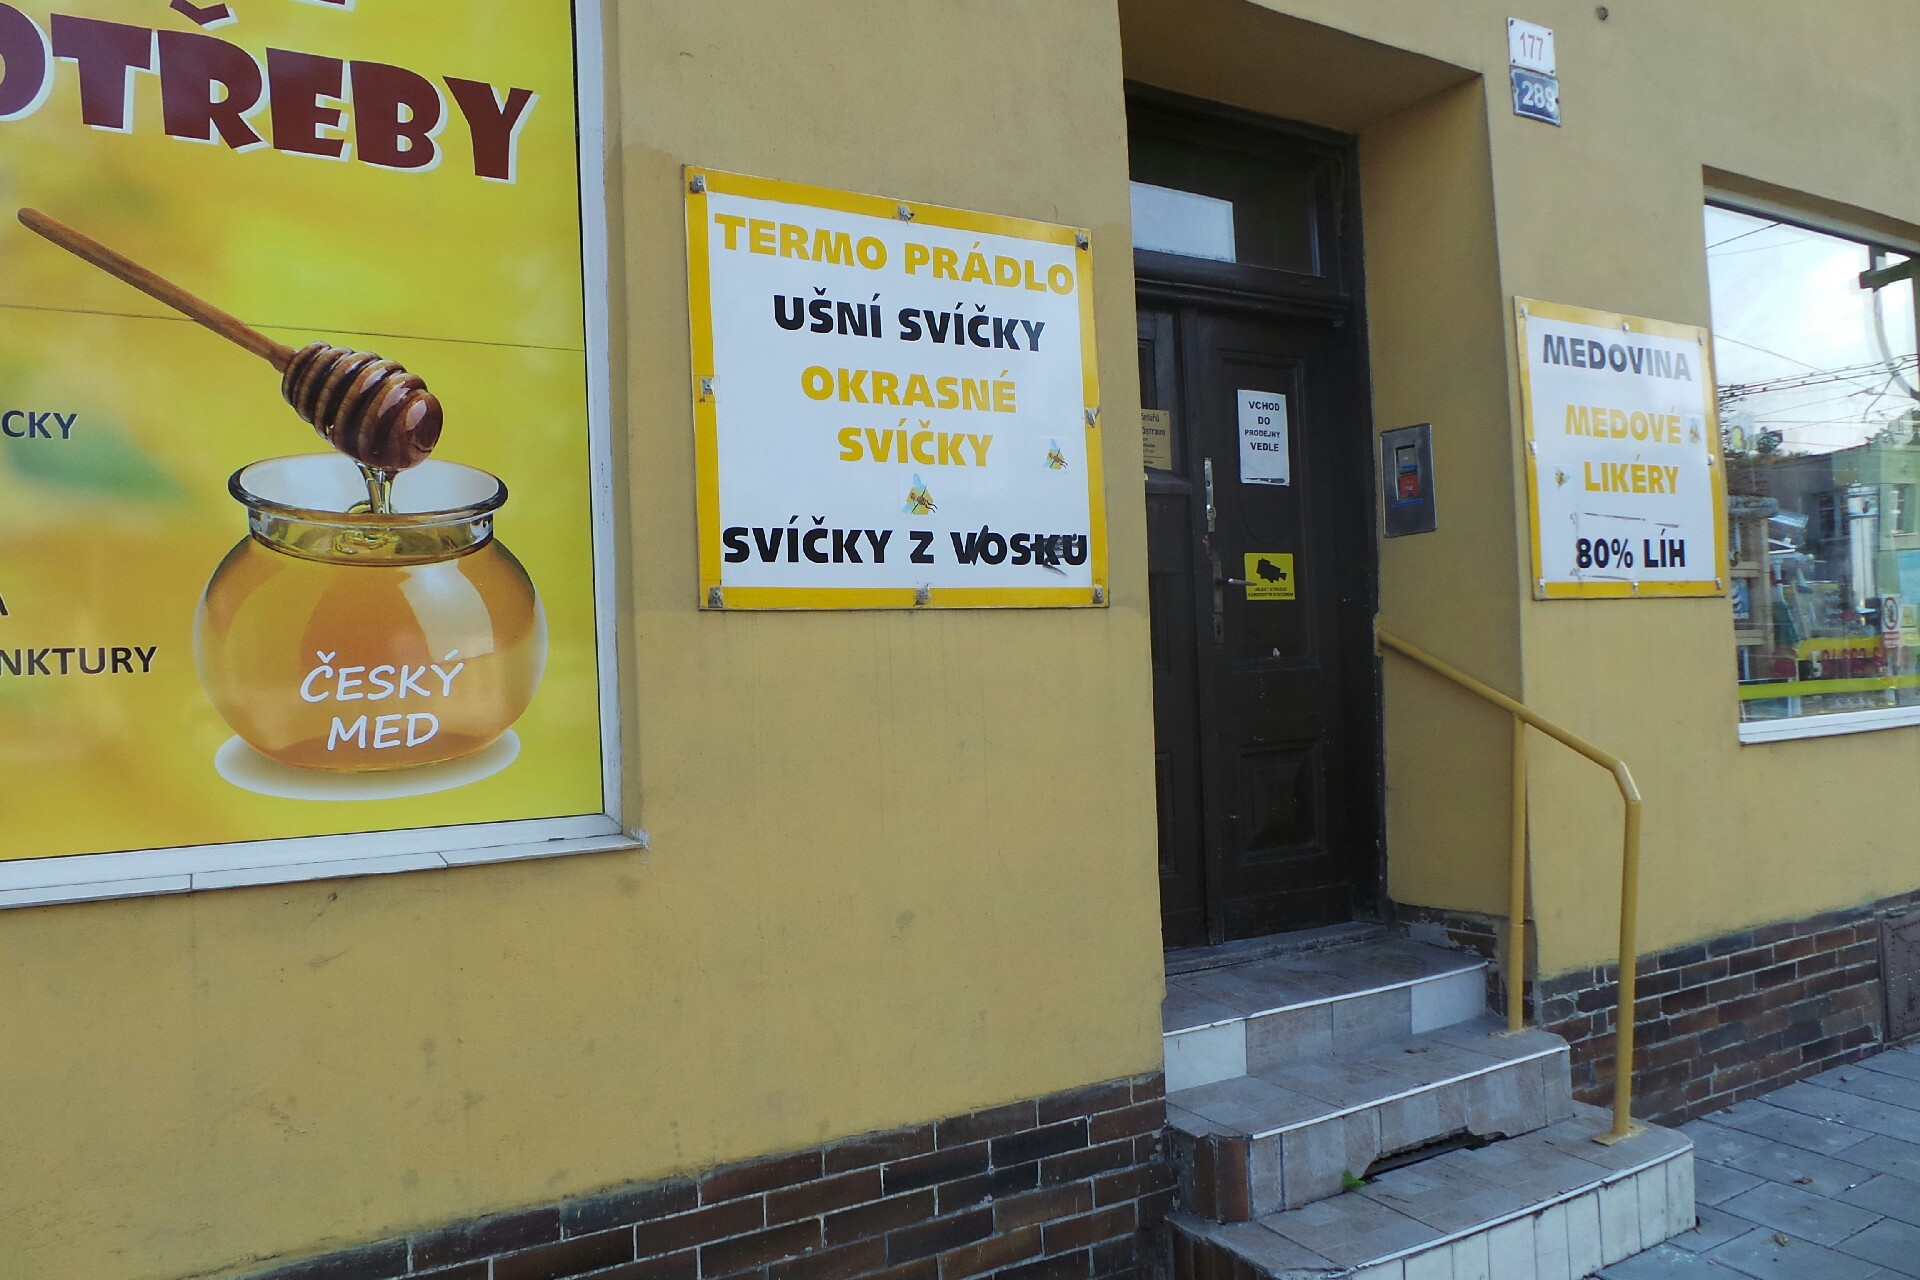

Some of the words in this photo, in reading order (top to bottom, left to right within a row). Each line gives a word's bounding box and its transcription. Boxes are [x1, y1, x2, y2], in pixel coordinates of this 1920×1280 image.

[1520, 32, 1544, 61] 177
[714, 213, 888, 271] TERMO
[904, 241, 1075, 295] PRÁDLO
[773, 287, 882, 339] UŠNÍ
[898, 302, 1046, 352] SVÍČKY
[1542, 334, 1692, 381] MEDOVINA
[801, 366, 1016, 413] OKRASNÉ
[1248, 401, 1280, 412] VCHOD
[1244, 429, 1281, 439] PRODEJNY
[1257, 416, 1271, 425] DO
[1565, 404, 1682, 444] MEDOVÉ
[837, 418, 993, 466] SVÍČKY
[1249, 442, 1279, 452] VEDLE
[1583, 454, 1679, 494] LIKÉRY
[722, 515, 894, 564] SVÍČKY
[909, 531, 935, 565] Z
[950, 531, 1088, 566] VOSKU
[1576, 538, 1634, 568] 80%
[1643, 529, 1686, 568] LÍH
[300, 648, 465, 703] ČESKÝ
[327, 712, 439, 751] MED
